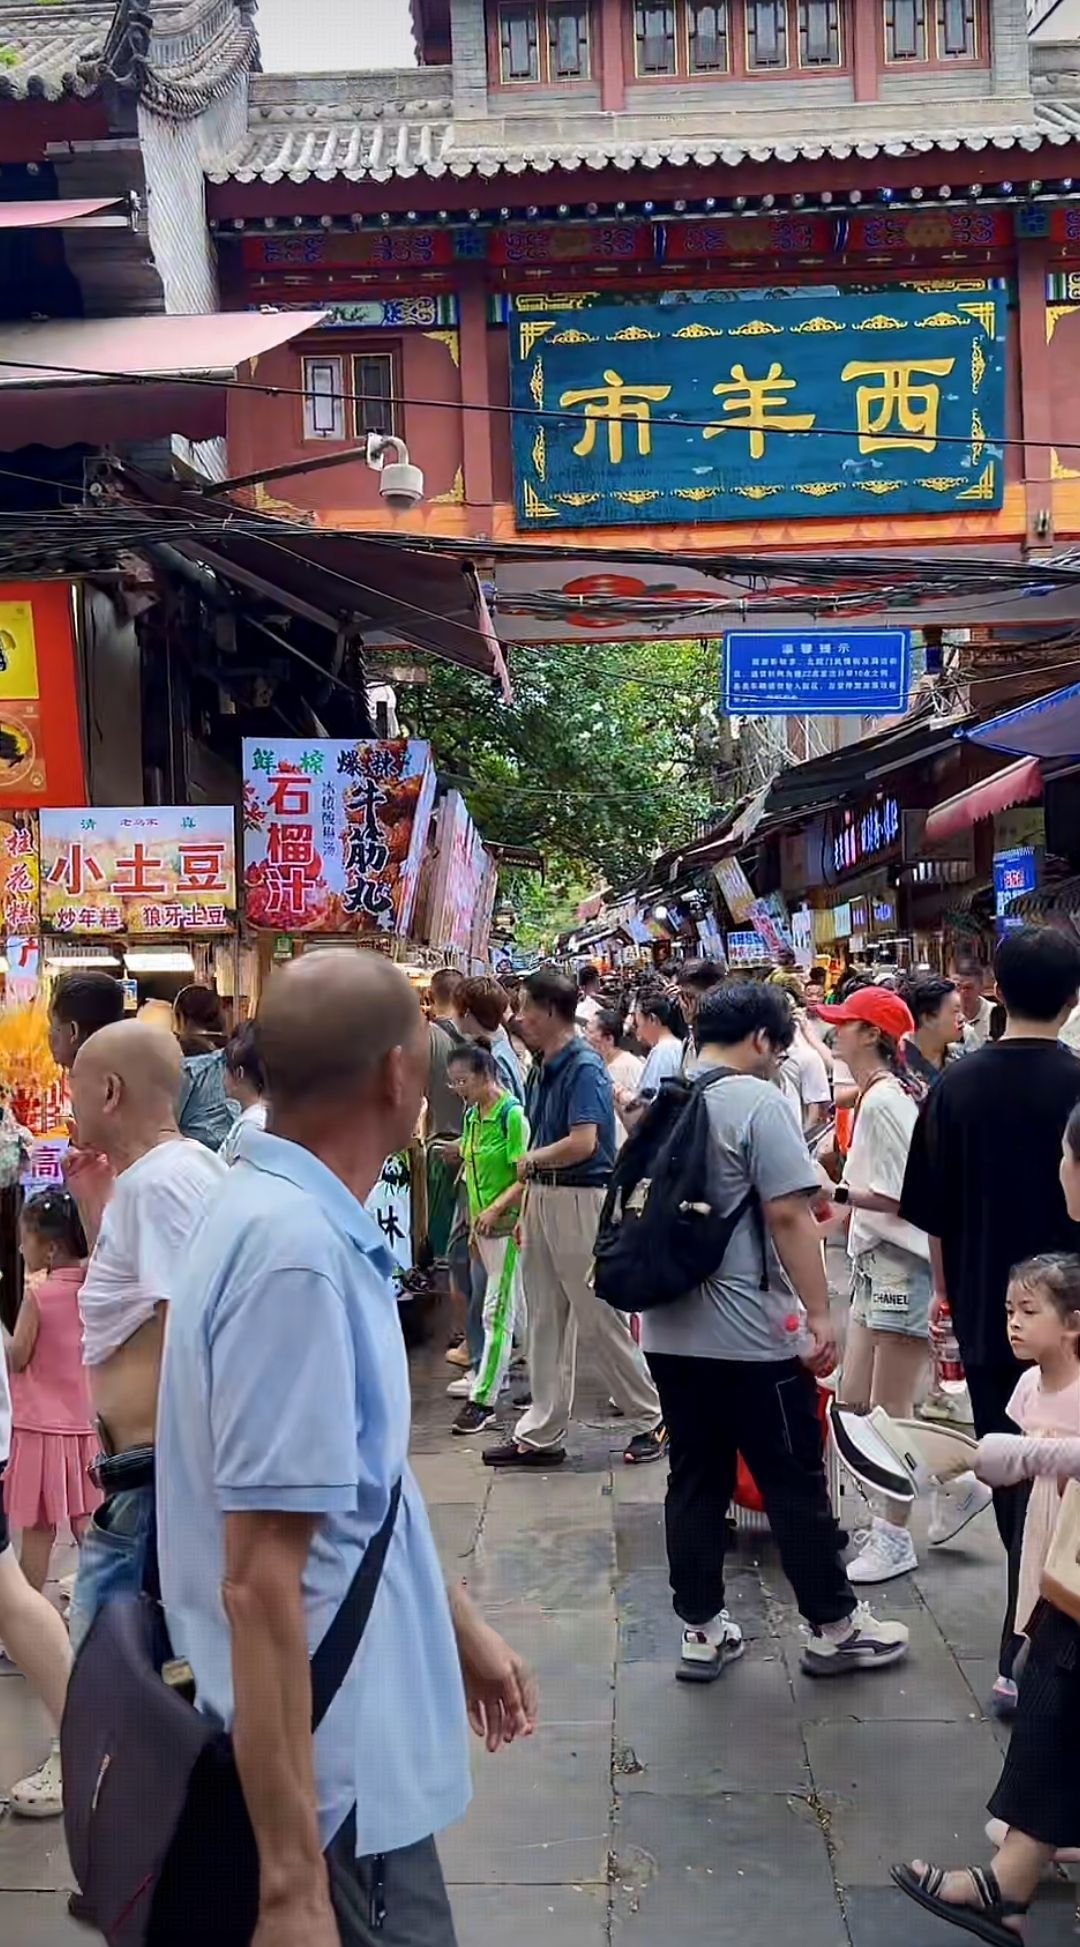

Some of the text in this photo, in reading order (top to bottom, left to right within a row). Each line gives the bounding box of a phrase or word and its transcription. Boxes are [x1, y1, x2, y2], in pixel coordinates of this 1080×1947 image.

[6, 828, 35, 926] 桂花糕
[48, 842, 229, 896] 小土豆
[265, 775, 316, 913] 石榴汁
[344, 779, 392, 914] 牛筋丸
[55, 904, 226, 931] 炒年糕 狼牙土豆
[873, 1293, 910, 1305] CHANEL
